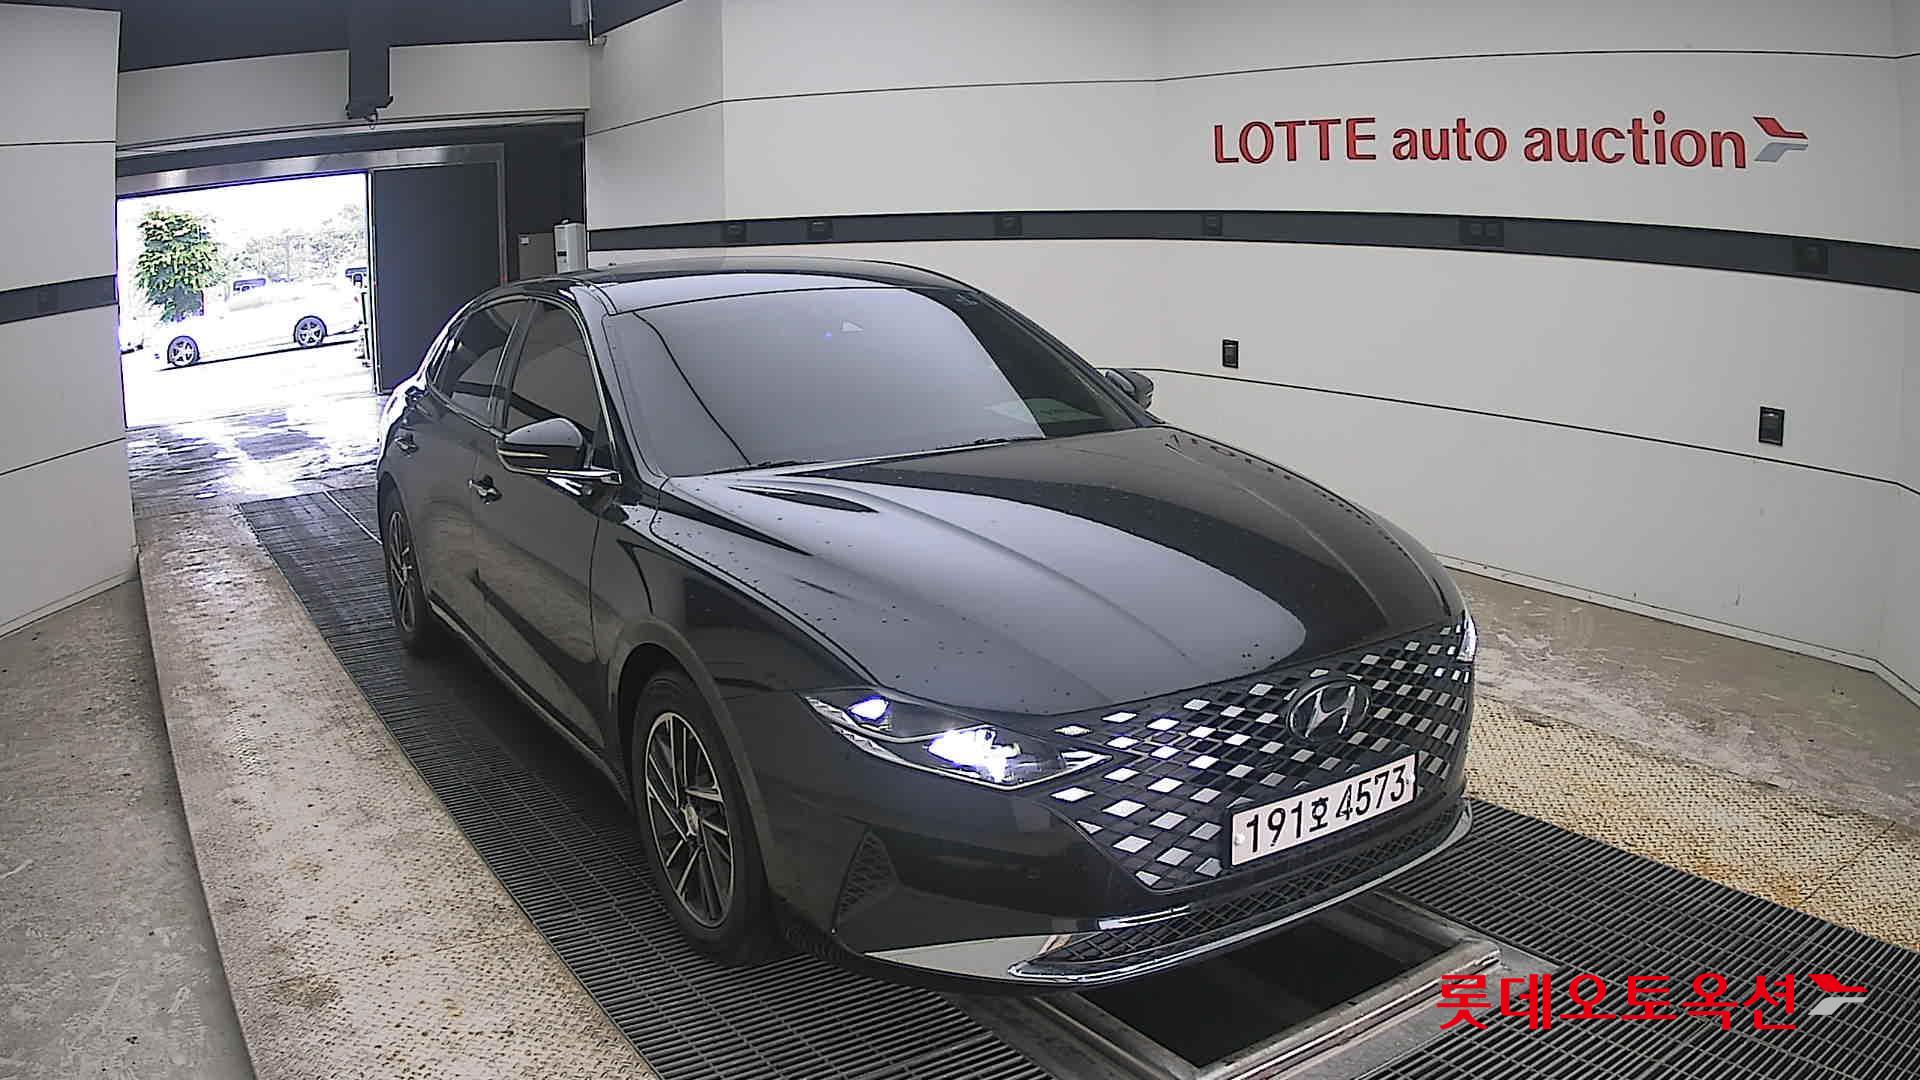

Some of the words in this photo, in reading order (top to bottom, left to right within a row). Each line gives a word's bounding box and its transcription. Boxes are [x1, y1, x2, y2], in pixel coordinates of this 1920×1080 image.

[1213, 116, 1376, 164] LOTTE
[1391, 117, 1509, 162] auto
[1523, 110, 1747, 168] auction
